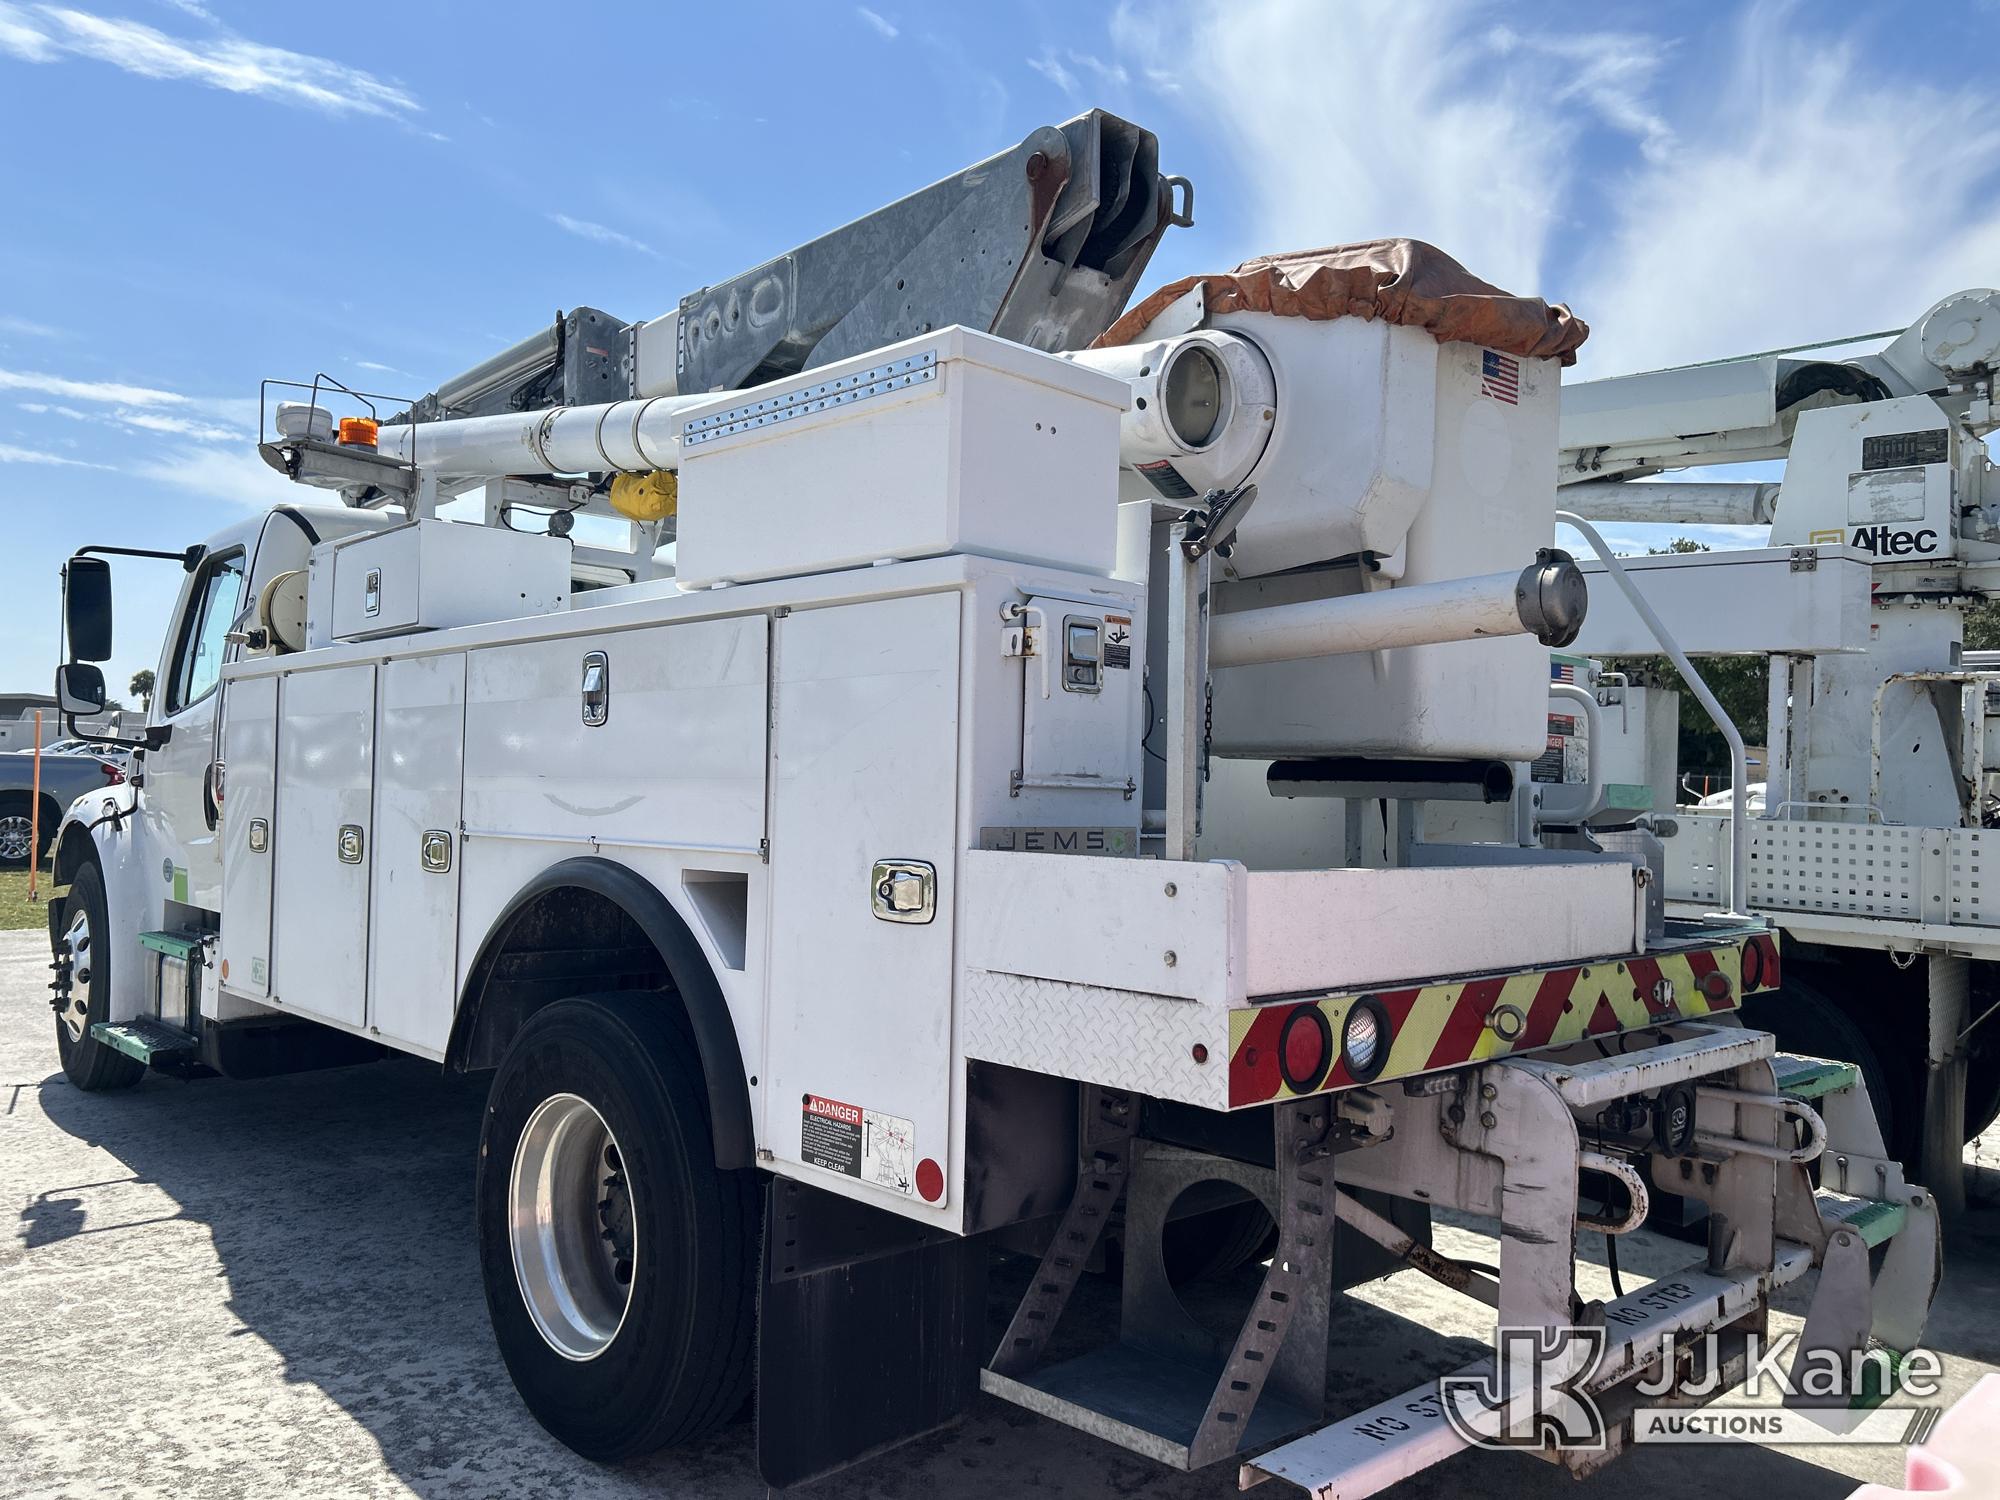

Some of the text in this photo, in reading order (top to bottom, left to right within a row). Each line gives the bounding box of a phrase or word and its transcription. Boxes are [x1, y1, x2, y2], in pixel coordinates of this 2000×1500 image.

[1851, 526, 1938, 557] Altec
[809, 1115, 833, 1127] ELECTRICAL
[818, 1101, 859, 1123] DANGER
[813, 1157, 846, 1173] KEEP CLEAR
[1606, 1283, 1697, 1326] NO STEP
[1353, 1416, 1411, 1442] NO
